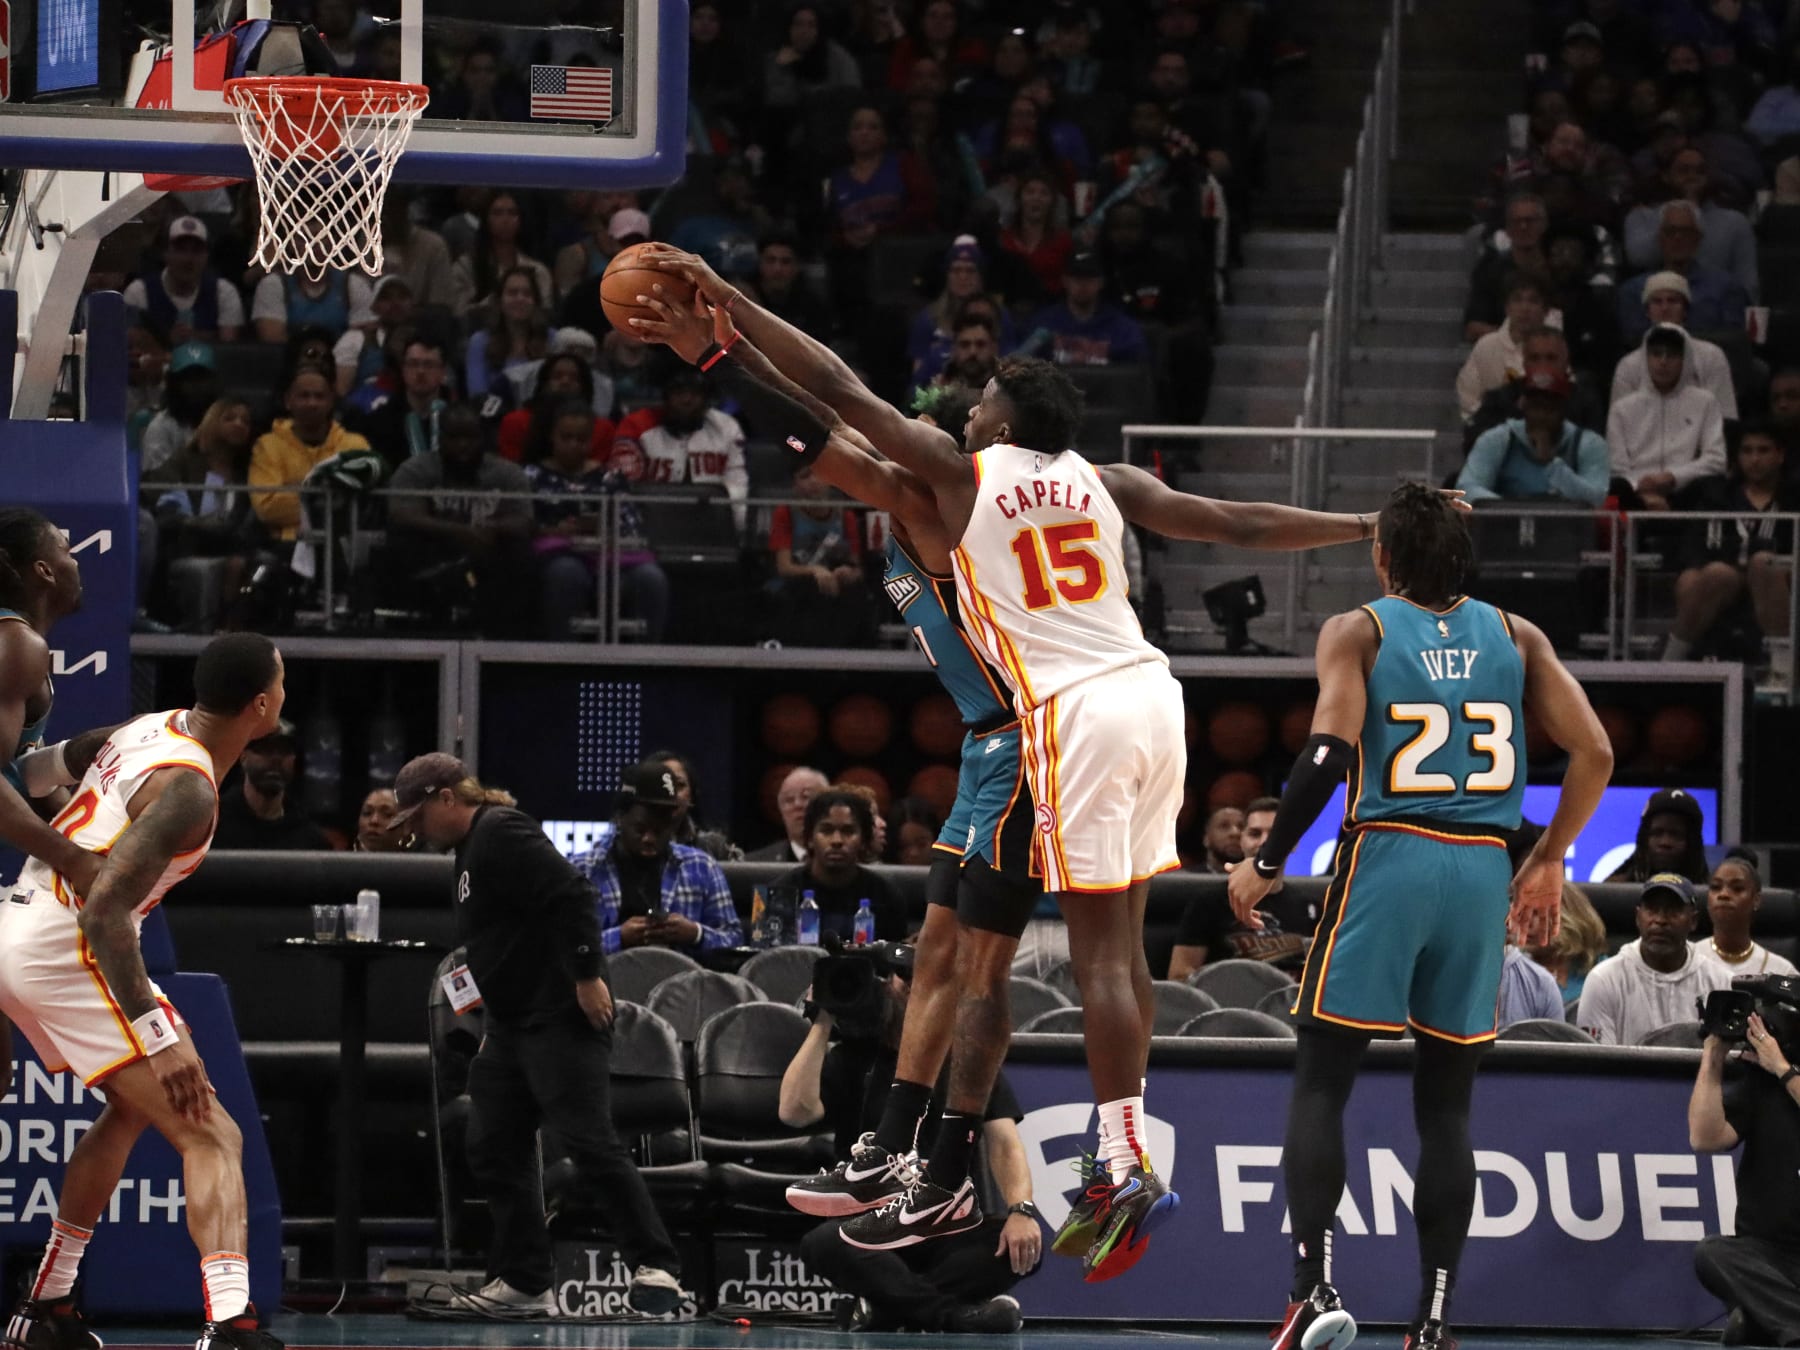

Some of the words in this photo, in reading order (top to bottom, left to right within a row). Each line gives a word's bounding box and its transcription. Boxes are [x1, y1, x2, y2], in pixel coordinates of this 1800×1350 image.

[995, 480, 1092, 519] CAPELA
[1009, 519, 1109, 612] 15
[1420, 649, 1479, 681] IVEY
[1383, 701, 1517, 798] 23
[744, 1249, 833, 1288] Litt
[717, 1279, 855, 1312] Caesar
